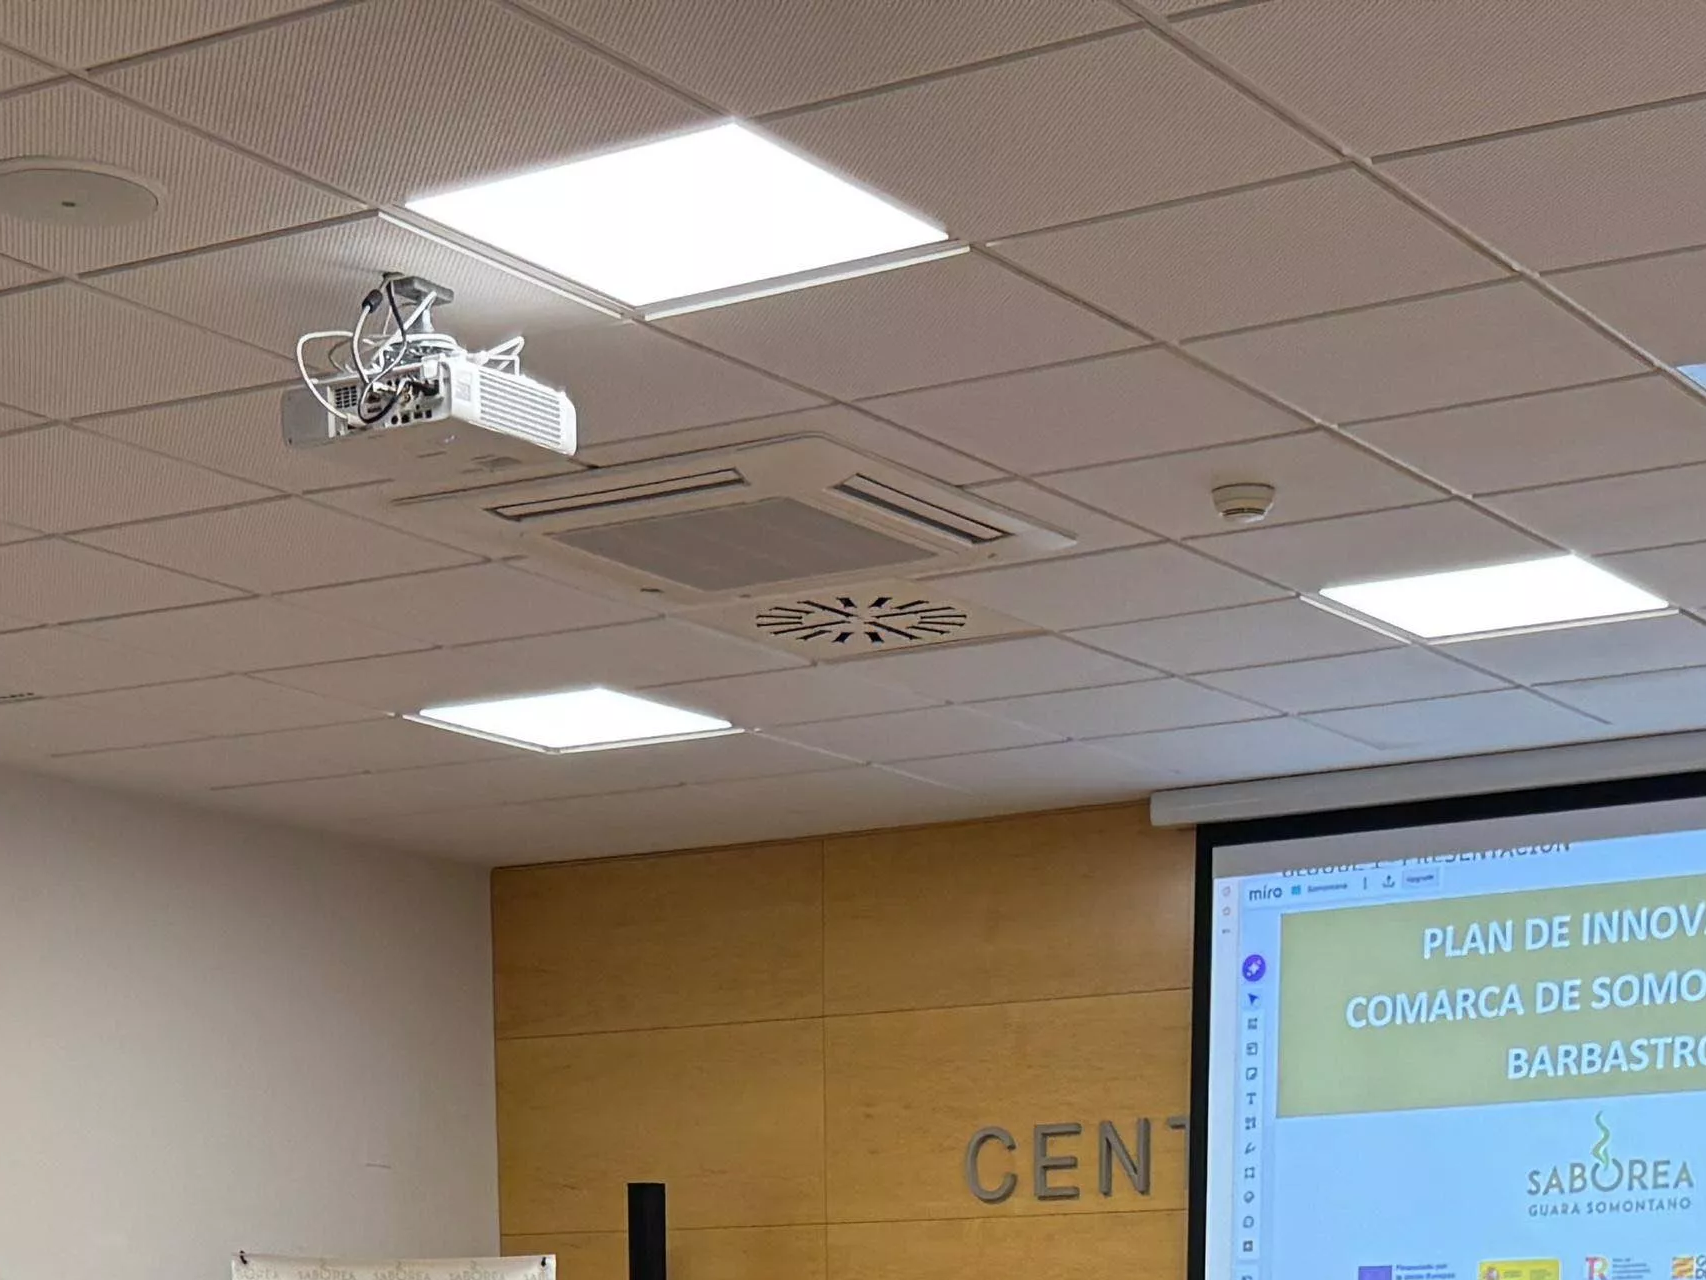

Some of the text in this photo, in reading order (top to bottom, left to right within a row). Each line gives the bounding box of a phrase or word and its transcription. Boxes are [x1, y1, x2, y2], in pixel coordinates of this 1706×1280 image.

[1248, 880, 1283, 901] miro
[1424, 918, 1513, 960] PLAN
[1525, 914, 1572, 951] DE
[1346, 985, 1525, 1030] COMARCA
[1535, 978, 1582, 1014] DE
[1527, 1157, 1694, 1195] SABOREA
[1528, 1197, 1692, 1217] GUARA SOMONTANO
